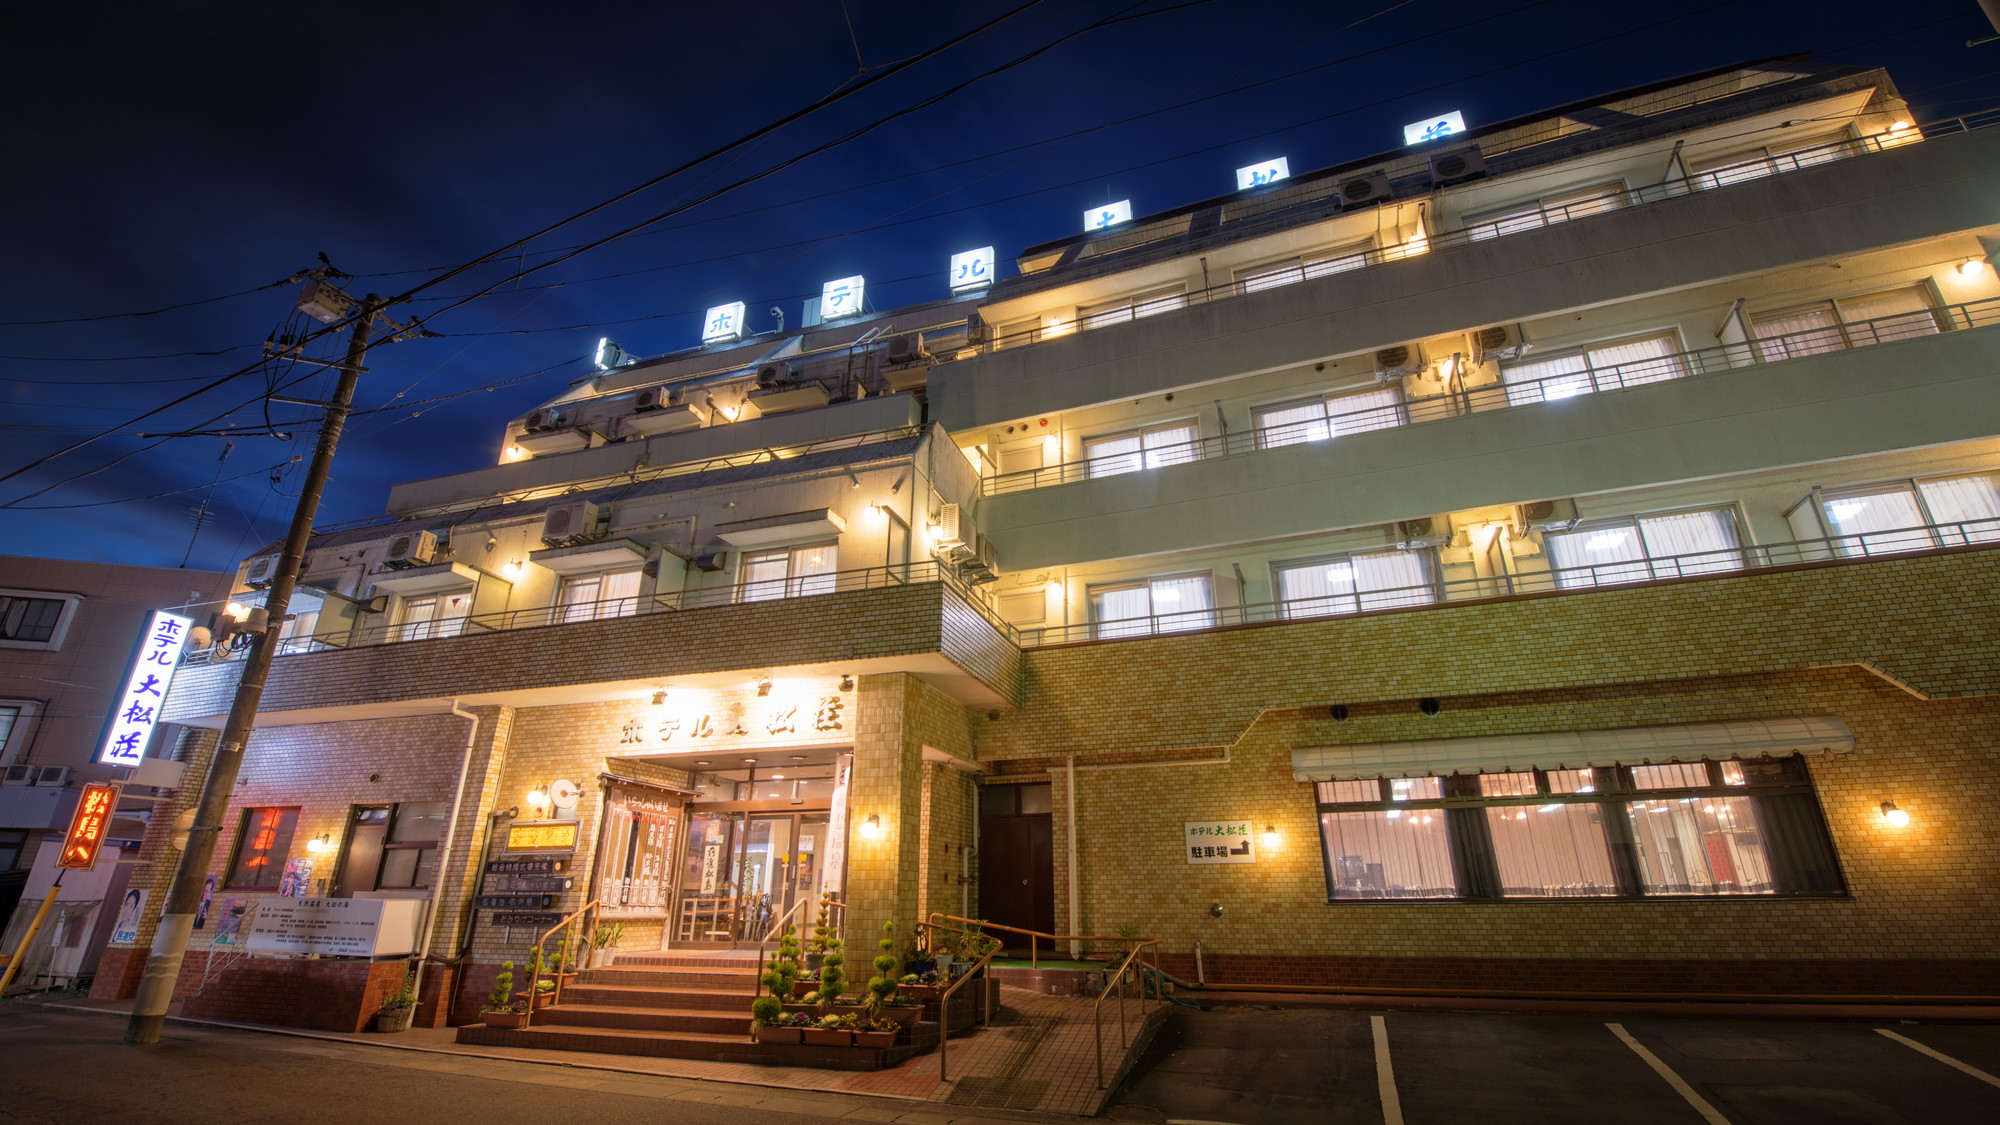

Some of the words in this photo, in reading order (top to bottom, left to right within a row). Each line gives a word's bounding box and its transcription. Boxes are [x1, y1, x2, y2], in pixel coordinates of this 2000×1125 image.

[147, 619, 182, 665] ホテル
[110, 674, 161, 759] 大松荘
[1191, 846, 1228, 858] 駐車場
[500, 914, 553, 924] おみやげコーナー
[116, 931, 136, 942] 民進党
